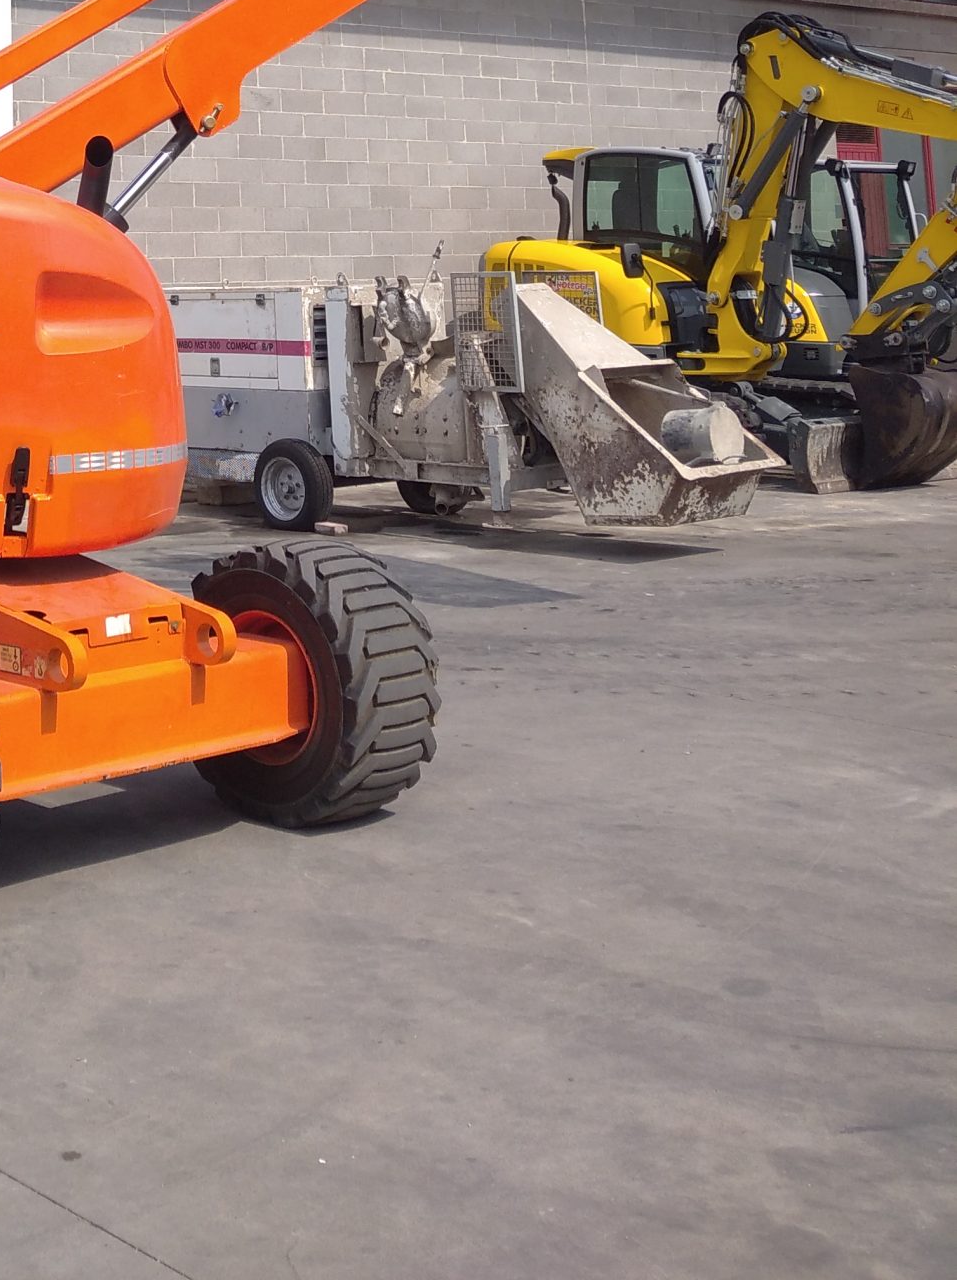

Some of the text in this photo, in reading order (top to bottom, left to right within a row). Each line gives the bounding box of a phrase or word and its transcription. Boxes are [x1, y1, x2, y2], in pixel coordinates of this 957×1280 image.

[194, 341, 207, 350] MST
[209, 342, 221, 350] 300
[226, 342, 257, 351] COMPACT
